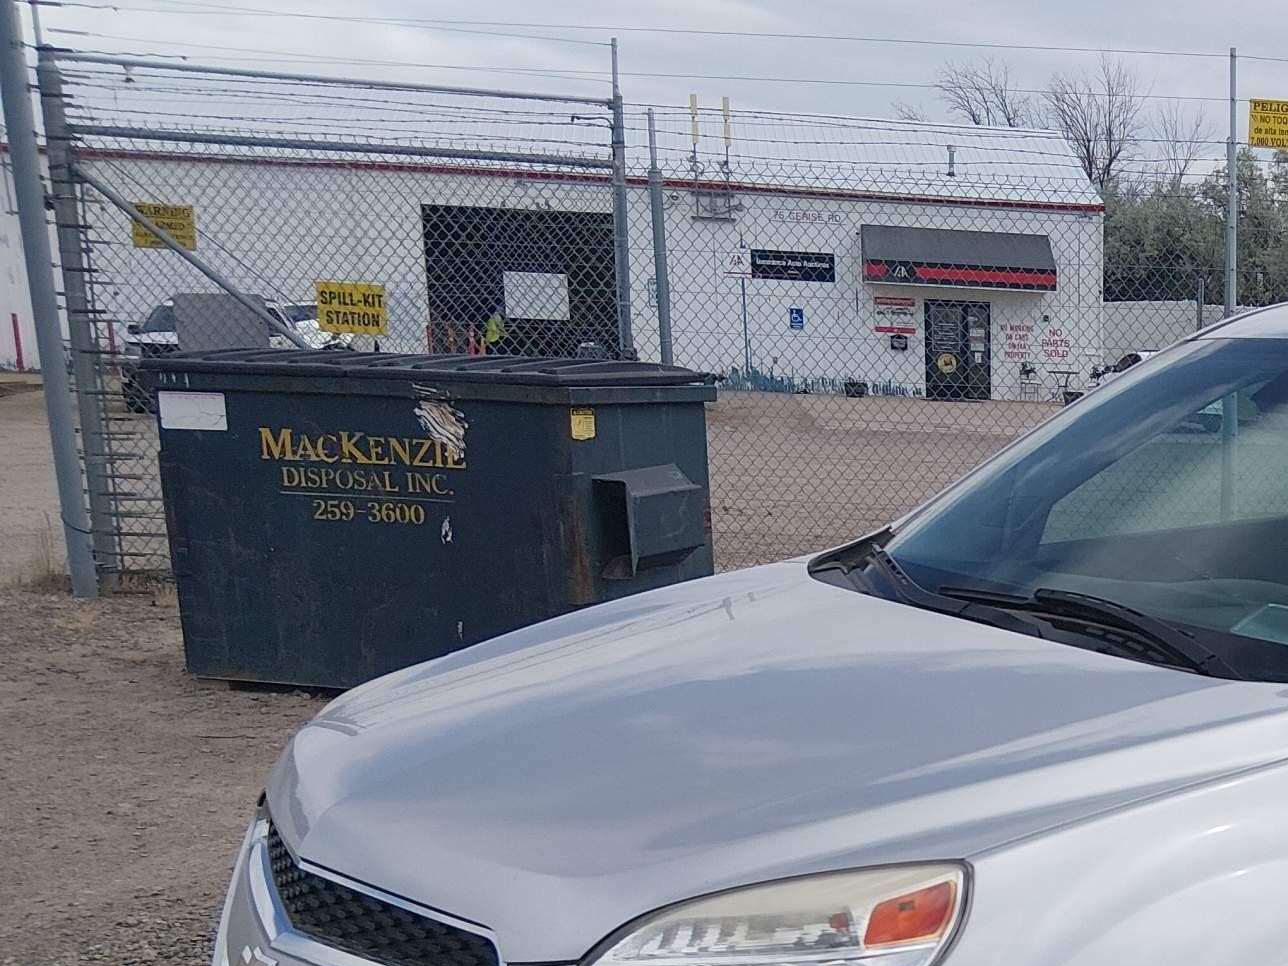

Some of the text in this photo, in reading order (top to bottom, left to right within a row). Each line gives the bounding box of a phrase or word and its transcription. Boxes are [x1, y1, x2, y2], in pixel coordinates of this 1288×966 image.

[1260, 115, 1271, 124] NO
[1254, 126, 1262, 134] de
[1264, 127, 1277, 135] alta
[320, 290, 384, 308] SPILL-KIT
[326, 310, 380, 327] STATION
[1049, 328, 1063, 337] NO
[1042, 339, 1070, 348] PARTS
[1044, 349, 1069, 358] SOLD
[281, 466, 455, 496] DISPOSAL INC.
[312, 499, 425, 525] 259-3600
